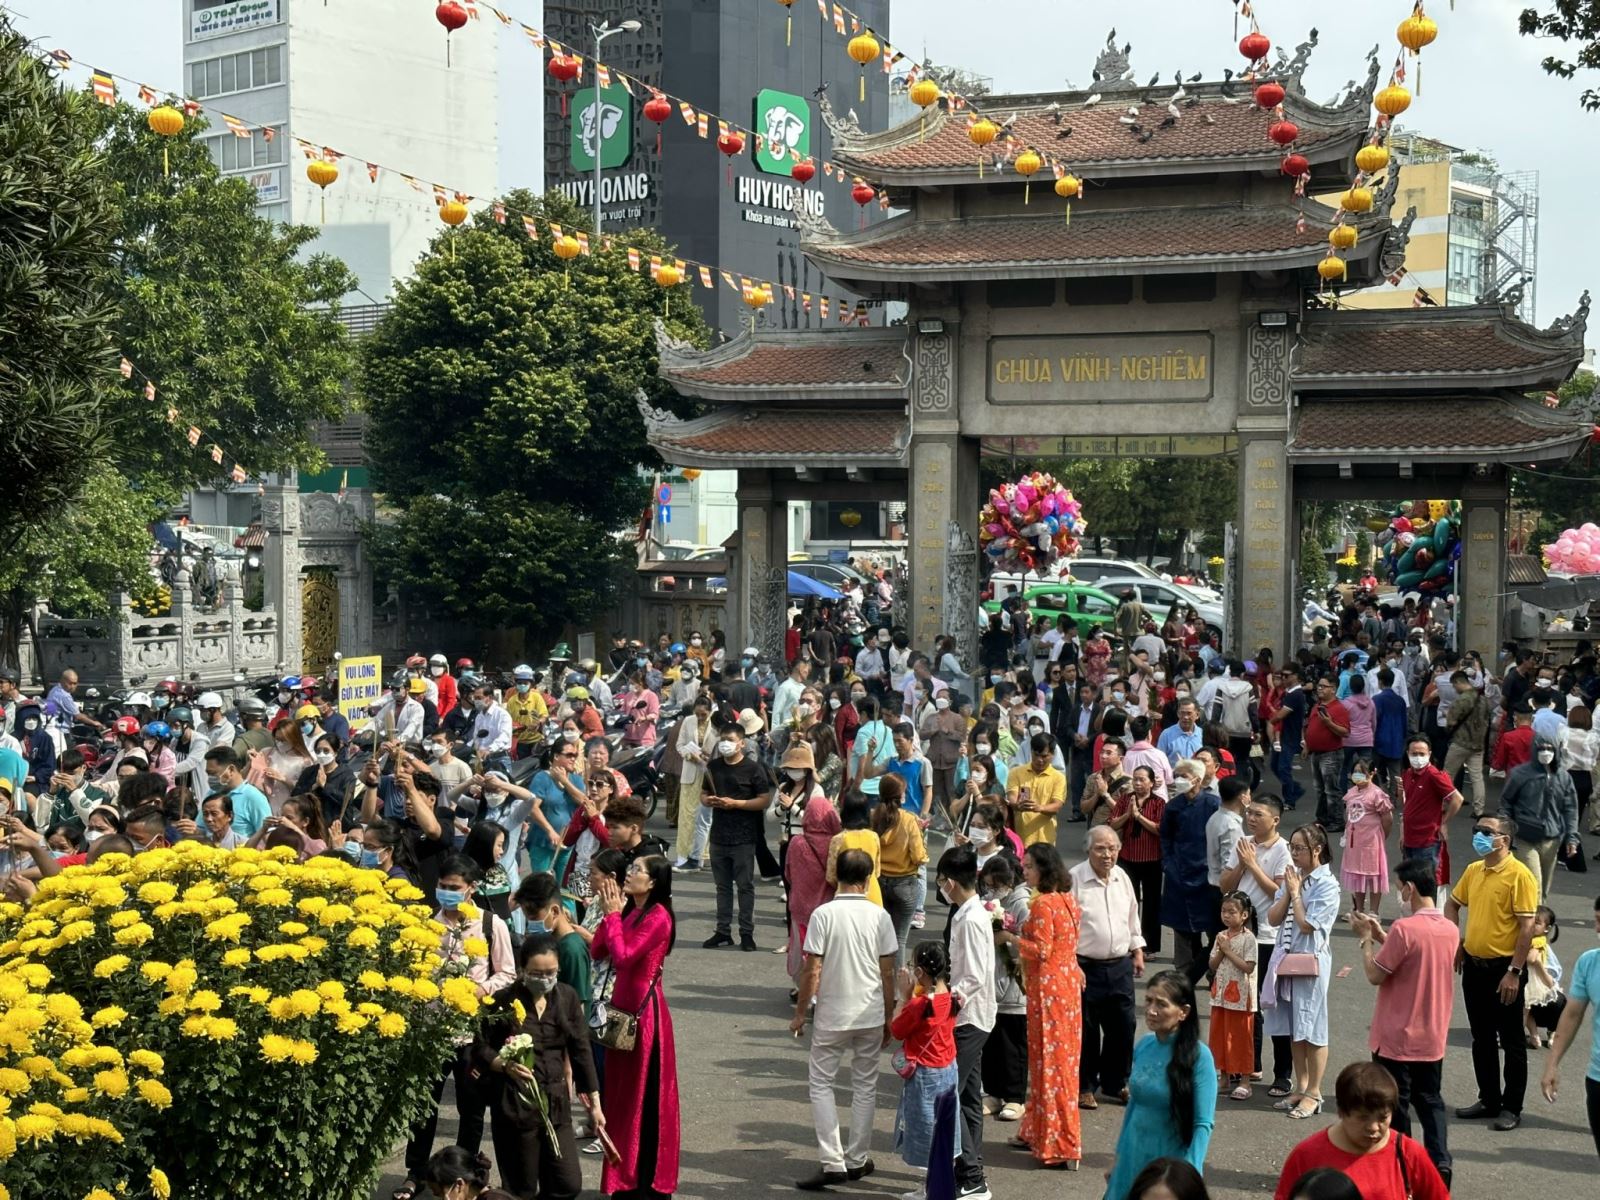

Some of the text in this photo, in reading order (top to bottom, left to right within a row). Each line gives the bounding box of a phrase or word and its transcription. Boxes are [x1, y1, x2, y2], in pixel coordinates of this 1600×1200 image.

[764, 214, 772, 225] an
[995, 352, 1052, 383] CHÙA
[346, 666, 356, 679] VUI
[354, 686, 363, 699] XE
